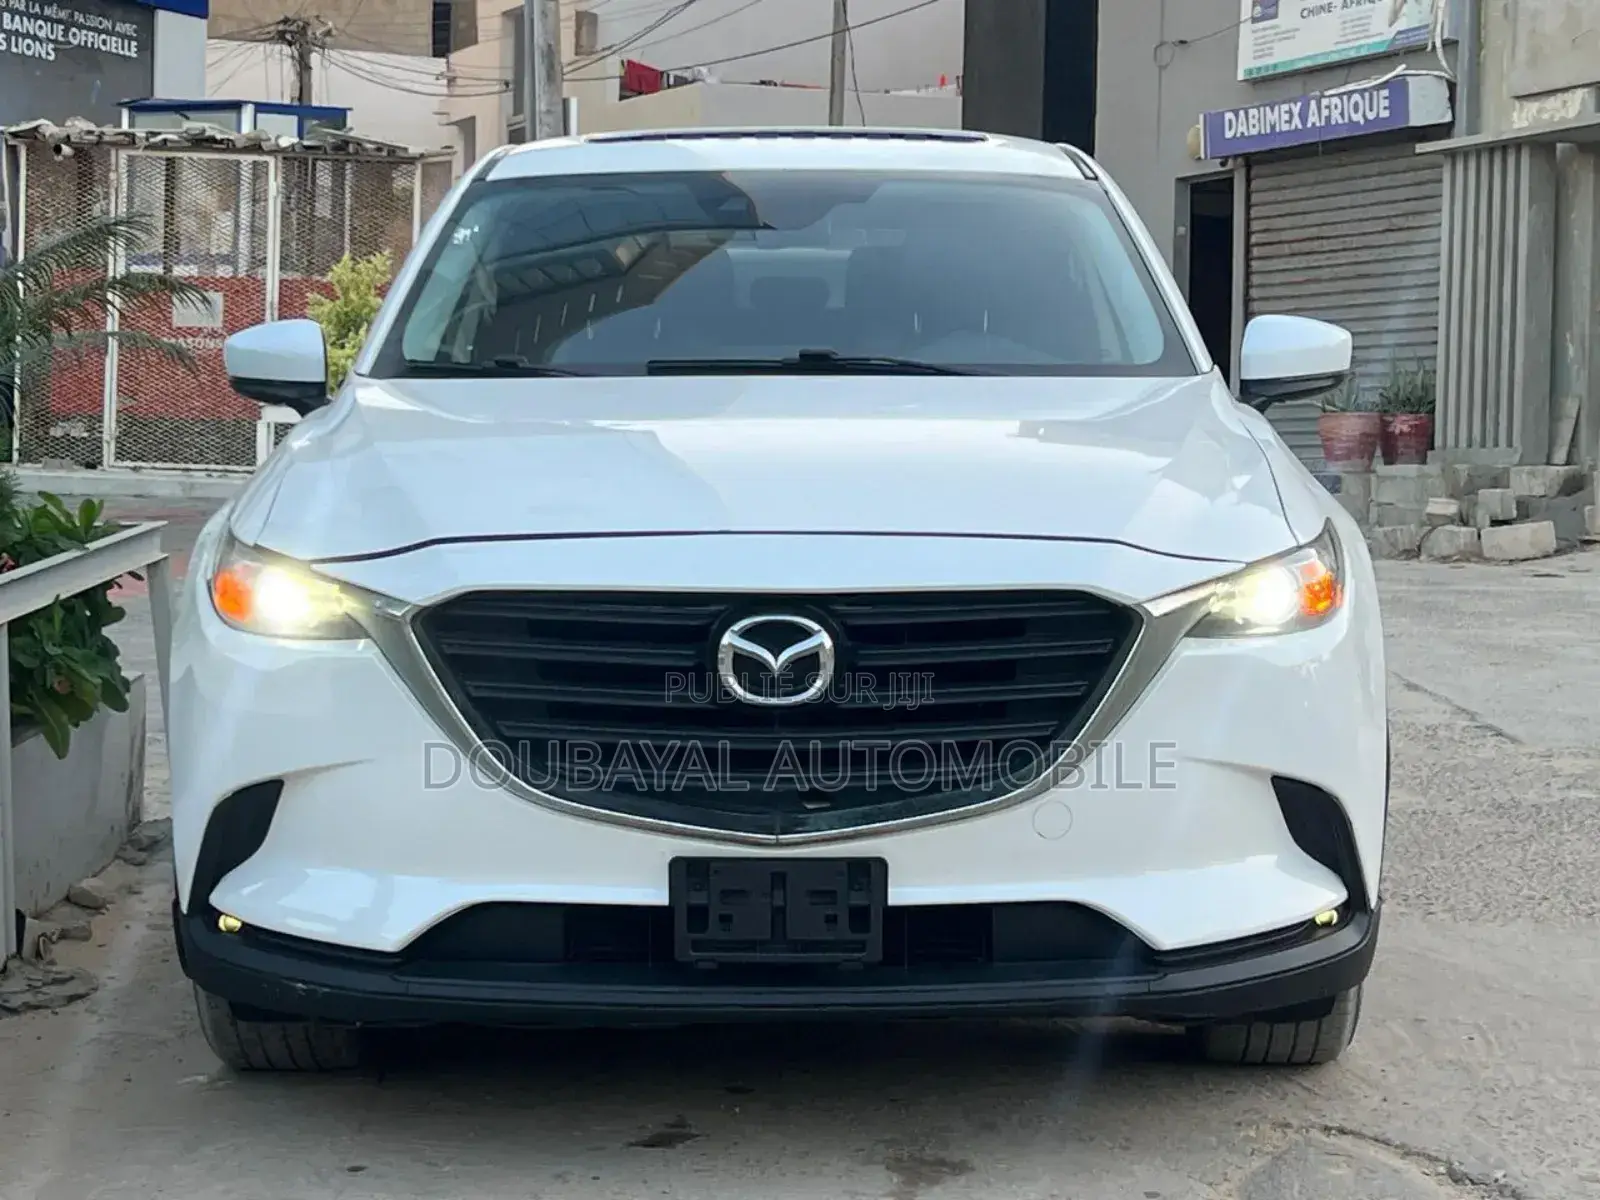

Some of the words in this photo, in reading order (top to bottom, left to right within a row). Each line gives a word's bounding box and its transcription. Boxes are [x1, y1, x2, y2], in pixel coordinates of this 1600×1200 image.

[3, 11, 65, 41] BANQUE
[69, 27, 138, 58] OFFICIELLE
[29, 1, 41, 15] LA
[74, 11, 112, 31] PASSION
[115, 21, 138, 37] AVEC
[11, 35, 55, 60] LIONS
[1224, 102, 1302, 139] DABIMEX
[1307, 88, 1390, 128] AFRIQUE
